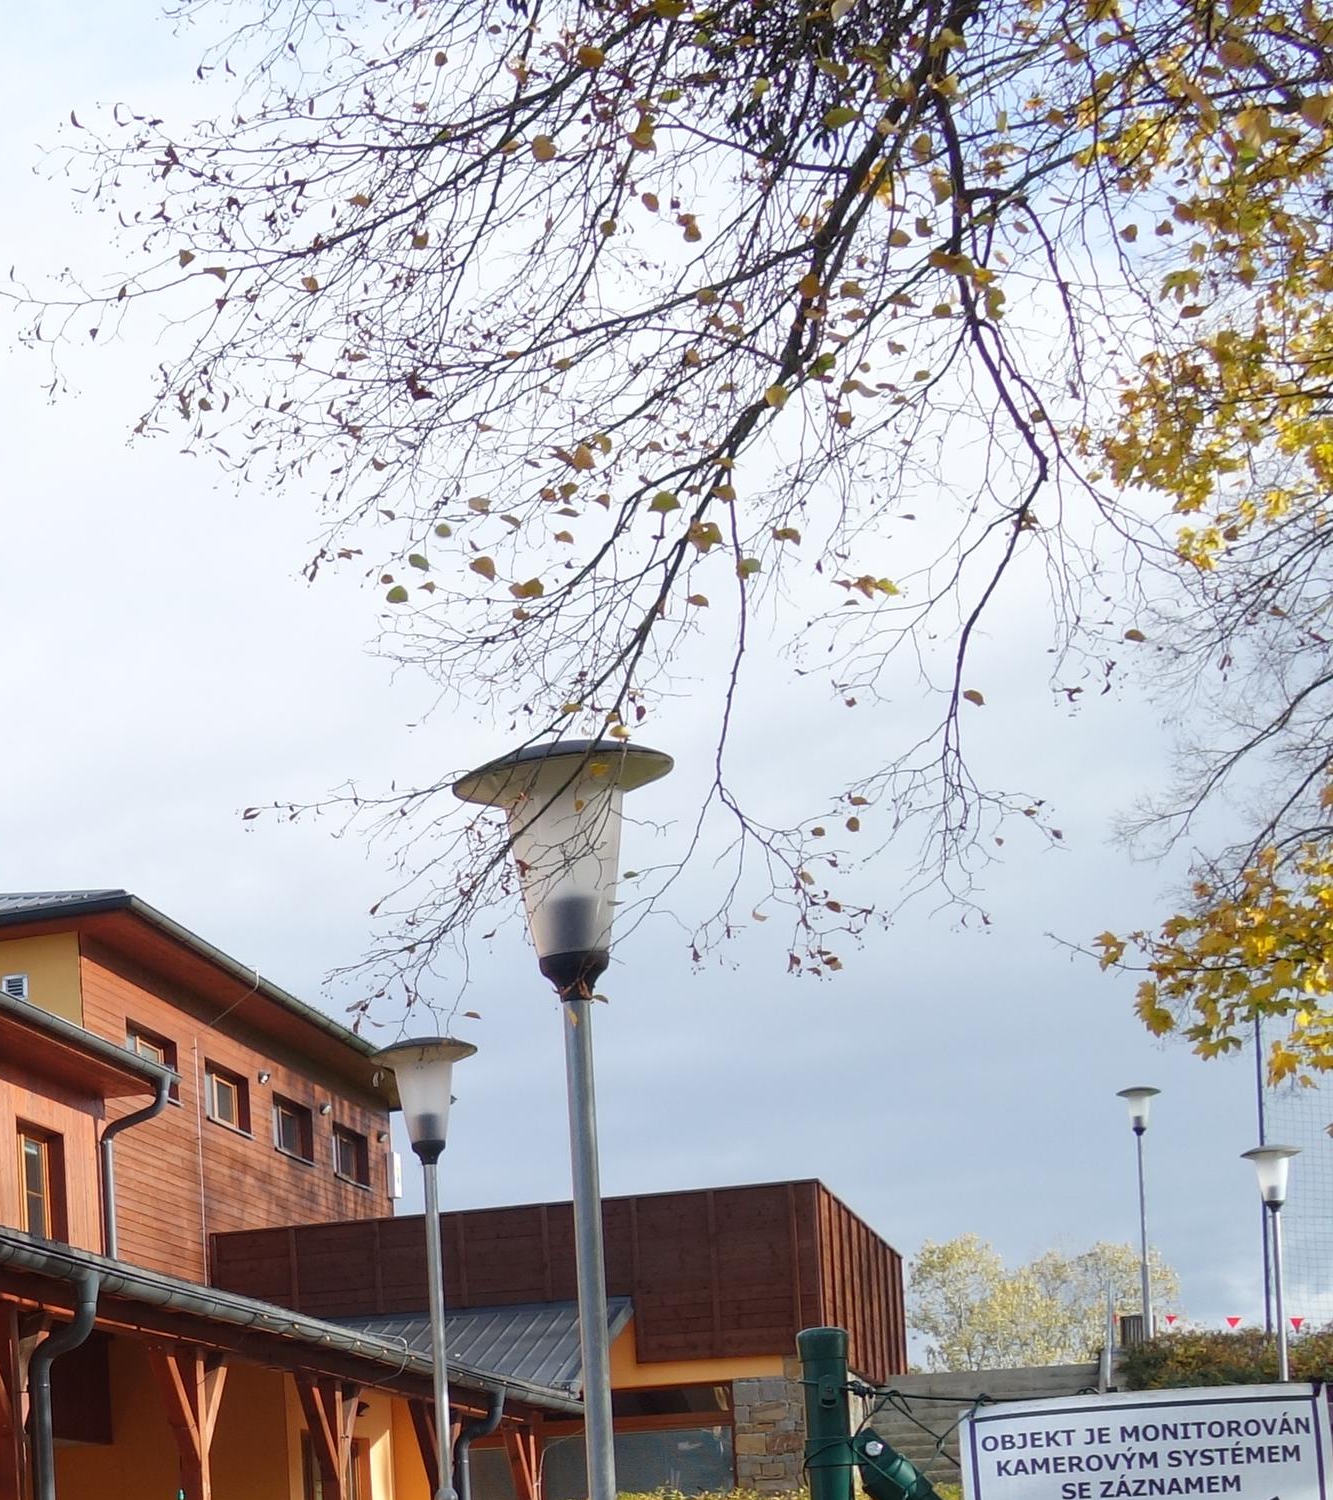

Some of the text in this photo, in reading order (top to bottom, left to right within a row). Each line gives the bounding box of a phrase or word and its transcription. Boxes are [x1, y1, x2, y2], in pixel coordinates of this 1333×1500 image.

[981, 1411, 1311, 1452] OBJEKT JE MONITOROVÁN
[996, 1441, 1301, 1477] KAMEROVÝM SYSTÉMEM
[1061, 1474, 1242, 1500] SE ZÁZNAMEM
